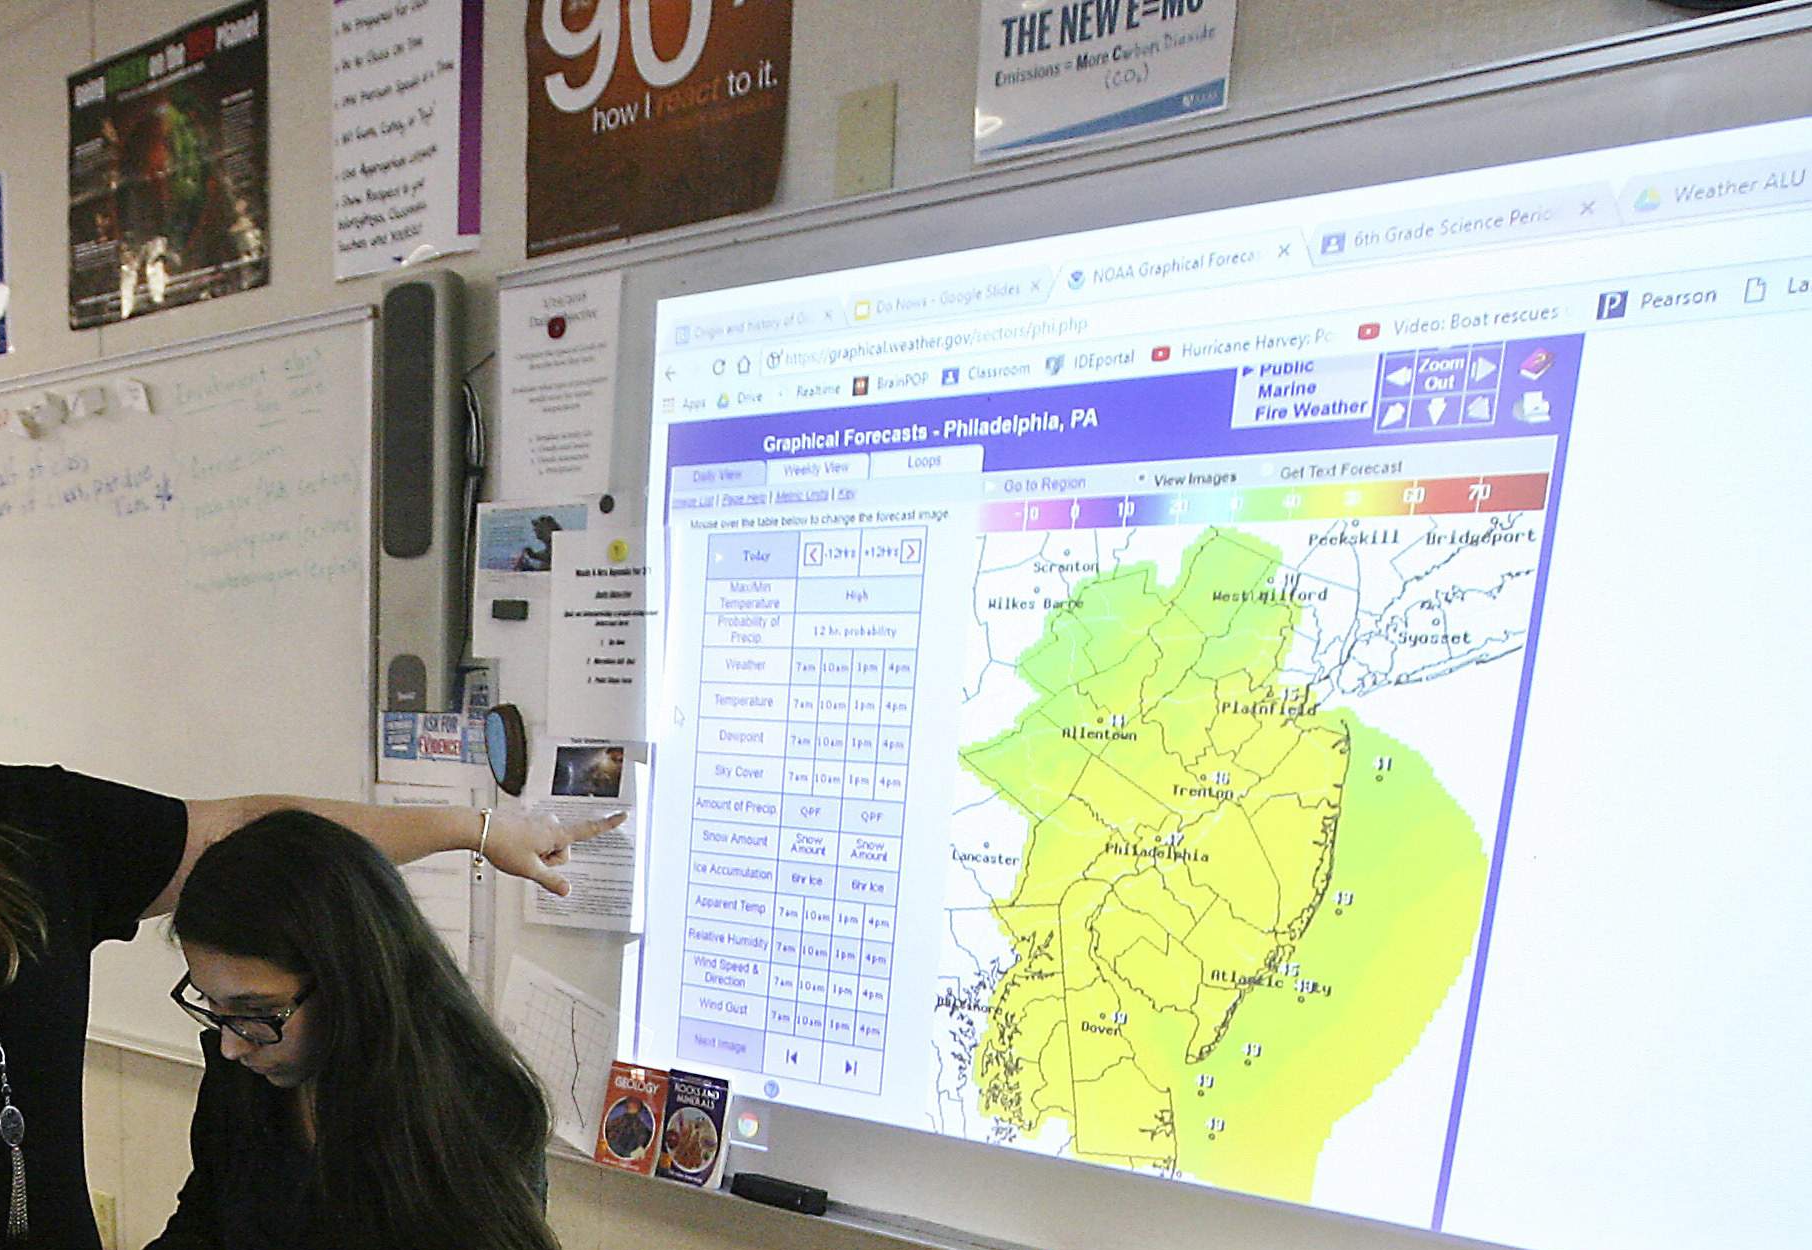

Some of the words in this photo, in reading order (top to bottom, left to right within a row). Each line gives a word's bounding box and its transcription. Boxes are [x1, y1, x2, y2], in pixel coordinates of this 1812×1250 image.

[1001, 9, 1053, 58] THE
[1060, 0, 1120, 46] NEW
[542, 0, 745, 113] 90
[995, 63, 1060, 88] Emissions
[1076, 52, 1109, 72] More
[1112, 42, 1160, 62] Carbon
[592, 103, 638, 135] how
[644, 92, 651, 119] I
[726, 70, 752, 98] to
[758, 59, 778, 90] it.
[1675, 178, 1759, 204] Weather
[1764, 168, 1807, 190] ALU
[1354, 231, 1381, 248] 6th
[1385, 225, 1435, 244] Grade
[1440, 214, 1505, 237] Science
[1093, 264, 1135, 284] NOAA
[1137, 256, 1205, 282] Graphical
[1641, 289, 1717, 310] Pearson
[1394, 318, 1446, 336] Video:
[1450, 311, 1489, 330] Boat
[1493, 304, 1559, 327] rescues
[1182, 339, 1251, 359] Hurricane
[1074, 349, 1136, 370] IDEportal
[1259, 359, 1316, 378] Public
[1418, 356, 1466, 374] Zoom
[968, 362, 1030, 381] Classroom
[877, 371, 930, 391] BrainPOP
[1257, 381, 1317, 399] Marine
[1424, 375, 1456, 392] Out
[738, 390, 764, 405] Drive
[1254, 403, 1288, 422] Fire
[1293, 398, 1370, 420] Weather
[763, 431, 840, 456] Graphical
[843, 423, 929, 447] Forecasts
[943, 411, 1065, 440] Philadelphia,
[1070, 406, 1100, 430] PA
[824, 462, 850, 475] View
[907, 454, 942, 469] Loops
[1280, 464, 1304, 480] Get
[1308, 462, 1337, 479] Text
[1340, 459, 1404, 479] Forecast
[1003, 478, 1022, 493] Go
[1025, 478, 1039, 492] to
[1041, 475, 1087, 493] Region
[1154, 474, 1184, 488] View
[1188, 470, 1238, 488] Images
[821, 511, 855, 527] change
[876, 509, 916, 523] forecast
[1308, 529, 1402, 547] Peekskill
[1426, 527, 1538, 548] Bridgeport
[743, 549, 771, 564] Today
[1033, 560, 1100, 574] Scranton
[719, 596, 781, 612] Temperature
[845, 588, 869, 603] High
[988, 597, 1036, 610] Wilkes
[1213, 590, 1250, 603] West
[717, 614, 770, 630] Probability
[772, 614, 781, 627] of
[844, 625, 898, 640] probability
[725, 657, 767, 672] Weather
[715, 694, 774, 709] Temperature
[1221, 700, 1319, 718] Plainfield
[1062, 726, 1138, 742] Allentown
[714, 764, 732, 778] Sky
[735, 766, 765, 779] Cover
[1173, 783, 1235, 801] Trenton
[696, 797, 731, 811] Amount
[734, 798, 744, 812] of
[800, 806, 822, 819] QPF
[861, 811, 884, 824] QPF
[702, 830, 729, 843] Snow
[731, 833, 769, 848] Amount
[796, 833, 824, 846] Snow
[855, 838, 885, 851] Snow
[790, 844, 826, 857] Amount
[850, 850, 889, 863] Amount
[952, 849, 1020, 867] Lancaster
[1104, 841, 1211, 863] Philadelphia
[694, 863, 707, 875] Ice
[709, 863, 774, 882] Accumulation
[809, 875, 824, 887] Ice
[869, 881, 885, 893] Ice
[695, 895, 739, 913] Apparent
[741, 900, 767, 915] Temp
[689, 928, 726, 945] Relative
[727, 933, 769, 951] Humidity
[693, 955, 719, 970] Wind
[720, 959, 750, 975] Speed
[704, 970, 747, 988] Direction
[699, 996, 724, 1012] Wind
[725, 1000, 749, 1015] Gust
[1081, 1020, 1121, 1036] Dover
[615, 1075, 660, 1095] GEOLOGY
[702, 1087, 720, 1101] AND
